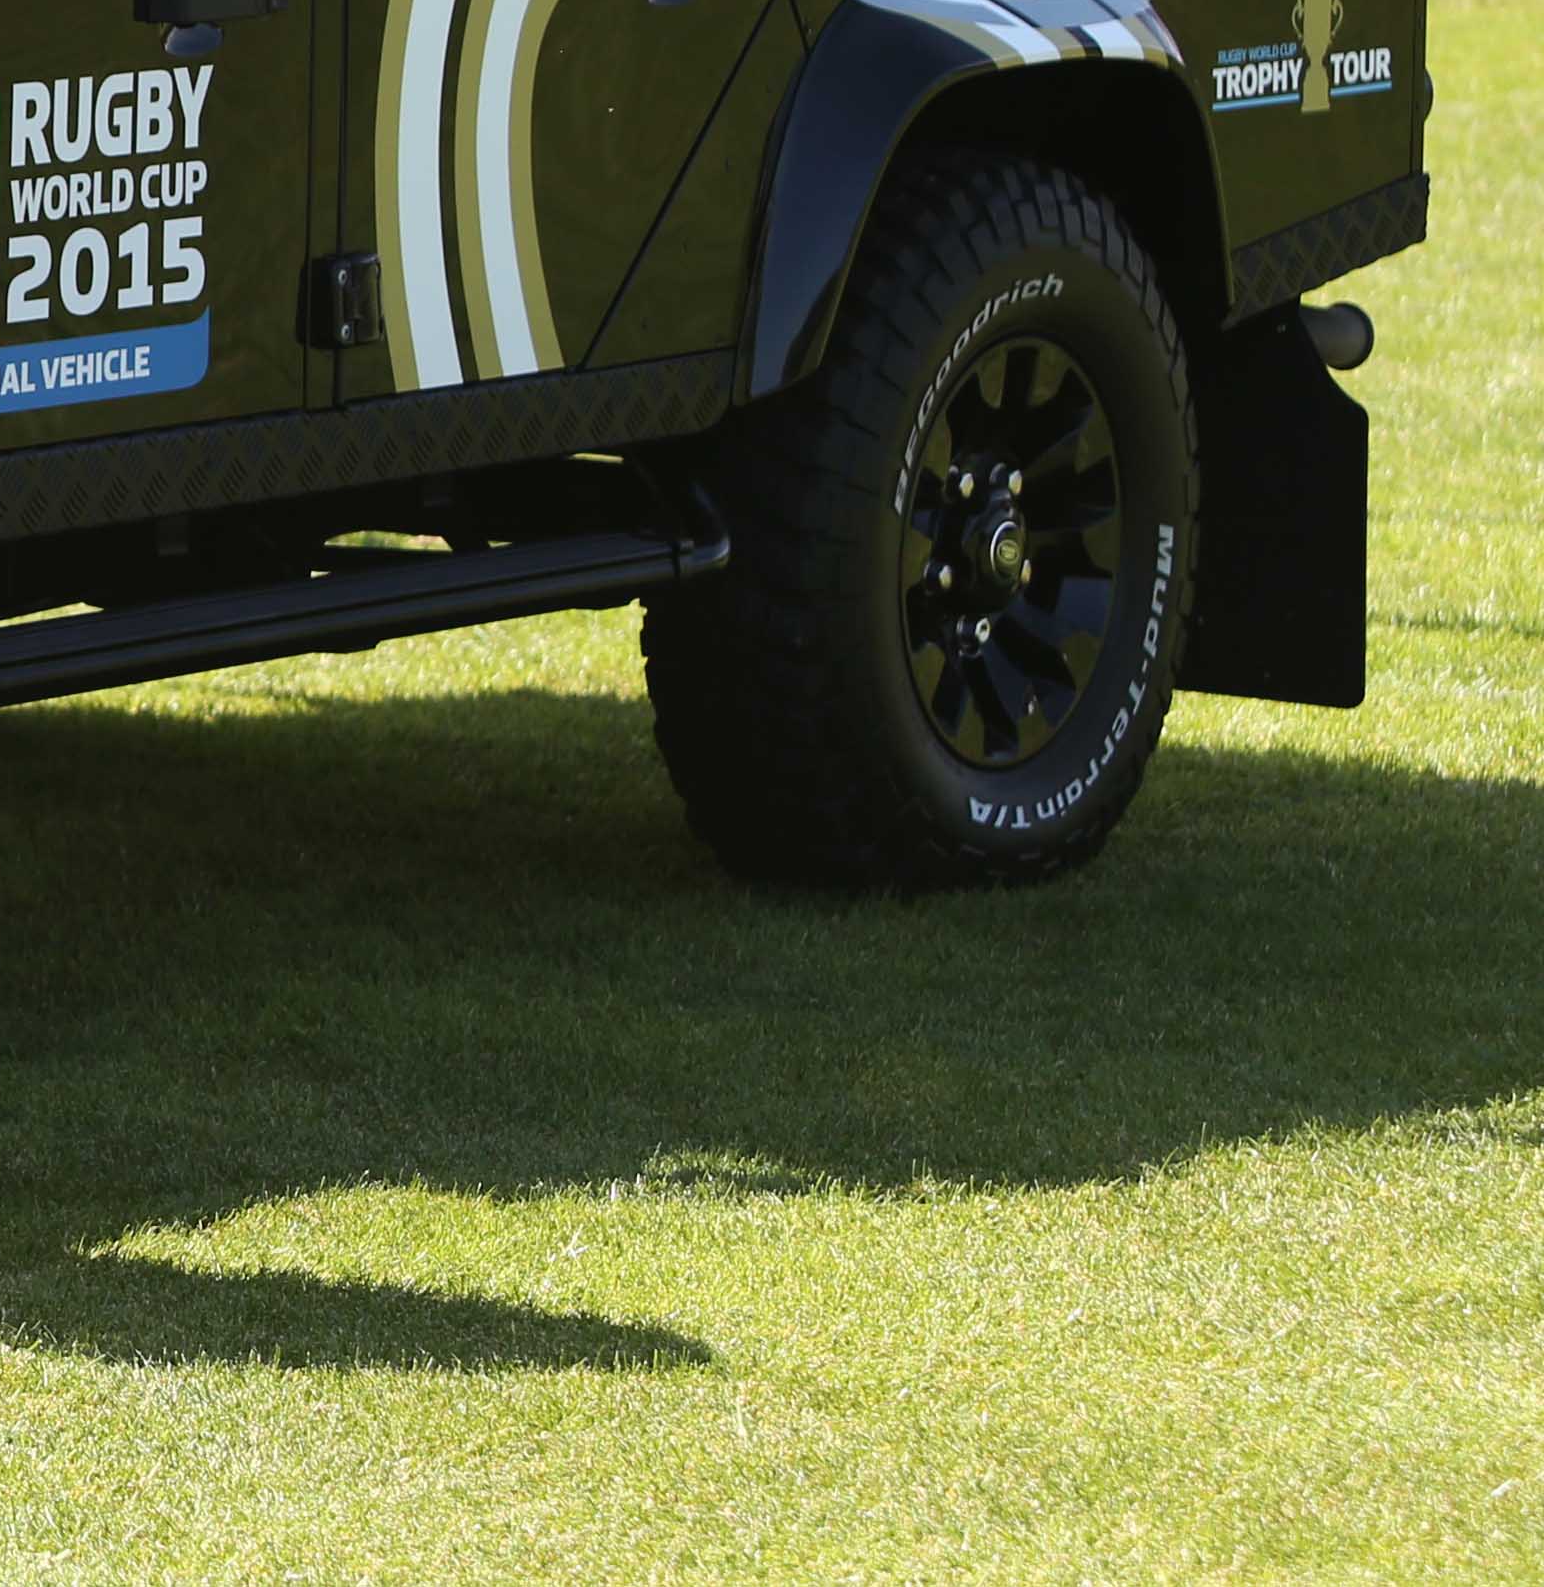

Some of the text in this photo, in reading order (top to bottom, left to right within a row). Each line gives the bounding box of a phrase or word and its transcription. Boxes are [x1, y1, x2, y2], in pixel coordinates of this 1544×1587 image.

[1212, 46, 1392, 101] TROPHY TOUR
[1249, 44, 1279, 61] WORLD
[1279, 42, 1298, 56] CUP
[11, 64, 214, 167] RUGBY
[10, 160, 209, 225] WORLD CUP
[6, 216, 206, 324] 2015
[41, 345, 151, 390] VEHICLE
[894, 272, 1064, 516] BFGoodrich
[1035, 523, 1175, 820] Mud-Terrain
